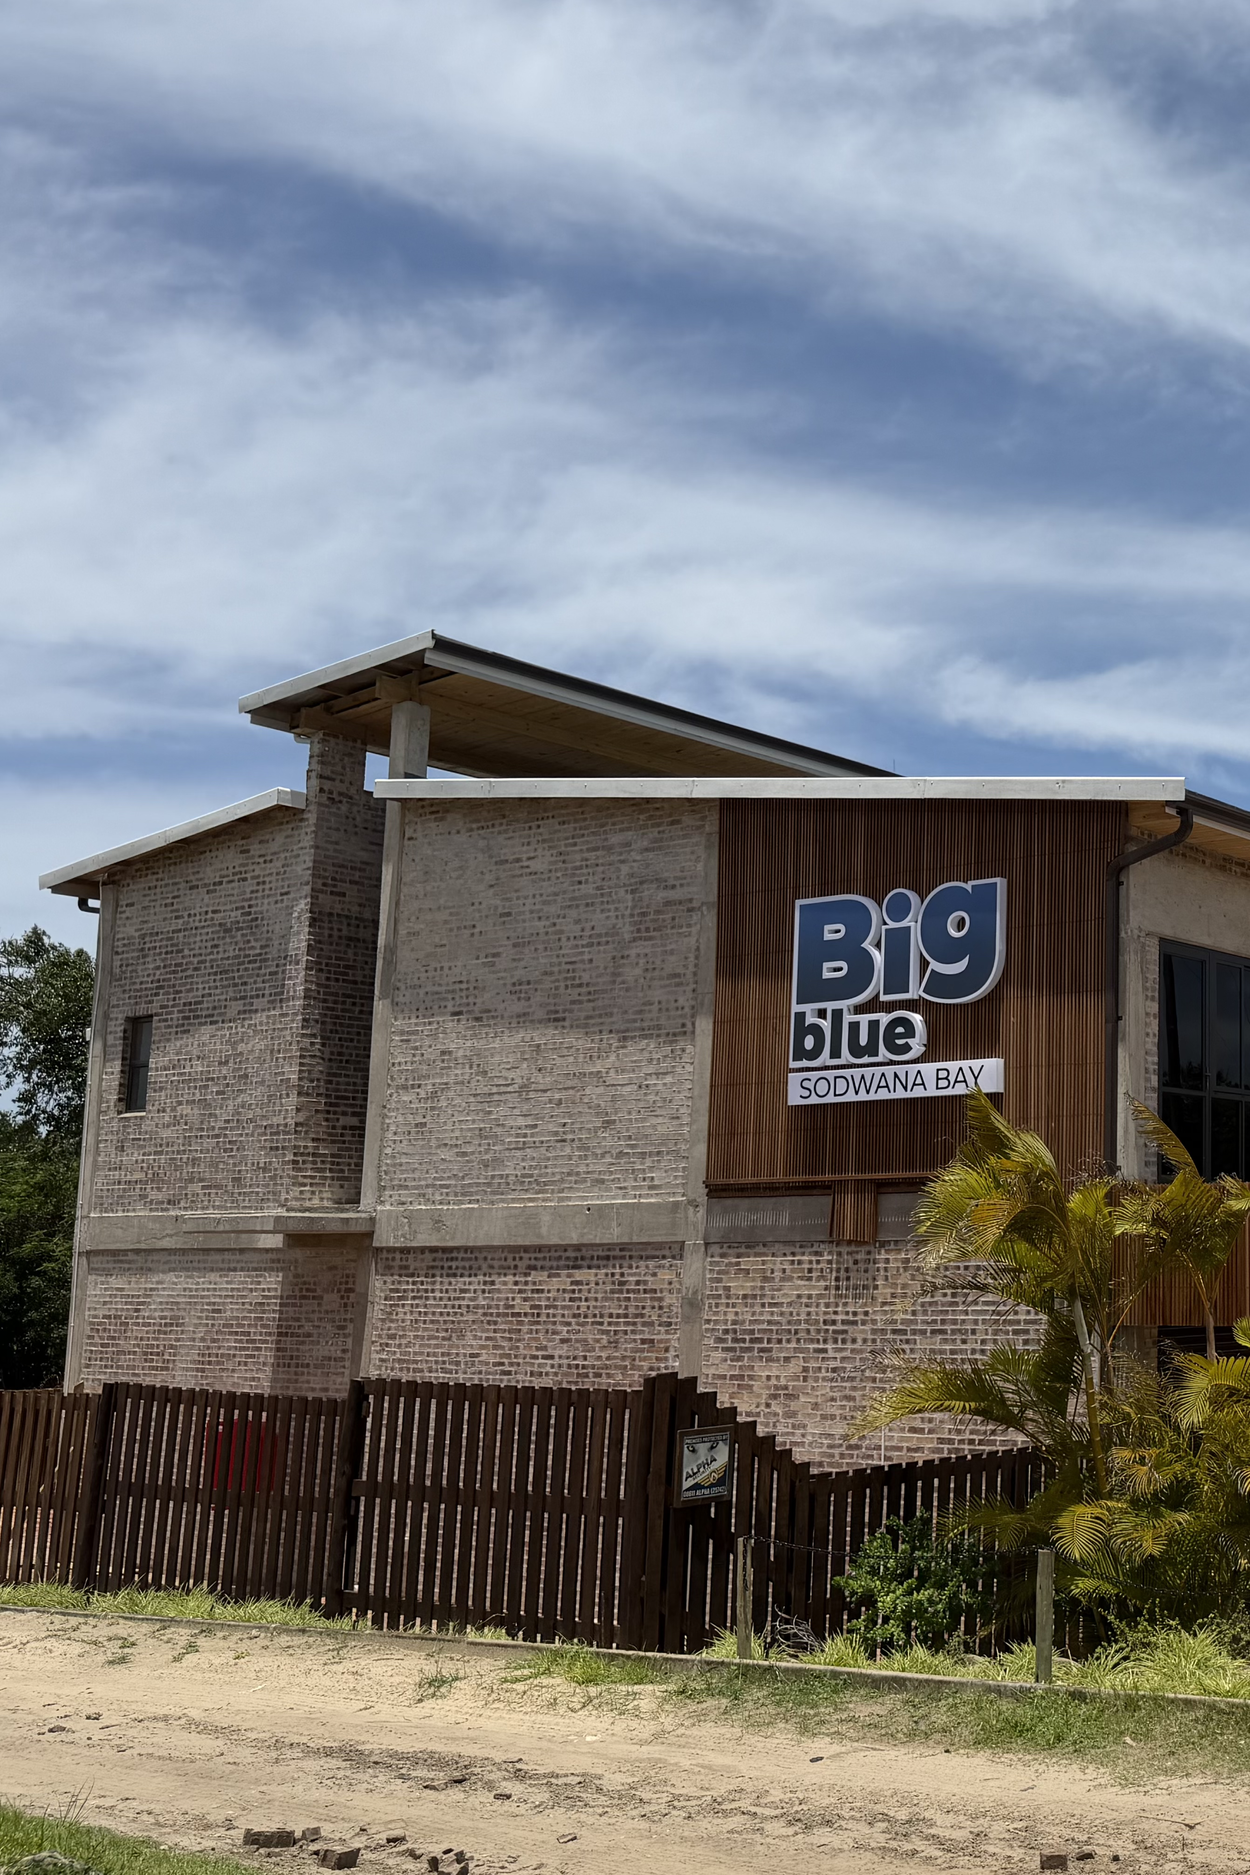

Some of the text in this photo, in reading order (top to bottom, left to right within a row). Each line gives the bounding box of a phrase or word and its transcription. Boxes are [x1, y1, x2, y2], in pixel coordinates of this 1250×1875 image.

[795, 877, 1006, 1004] Big
[790, 1008, 927, 1067] blue
[799, 1065, 984, 1099] SODWANA BAY
[685, 1454, 717, 1482] ALPHA
